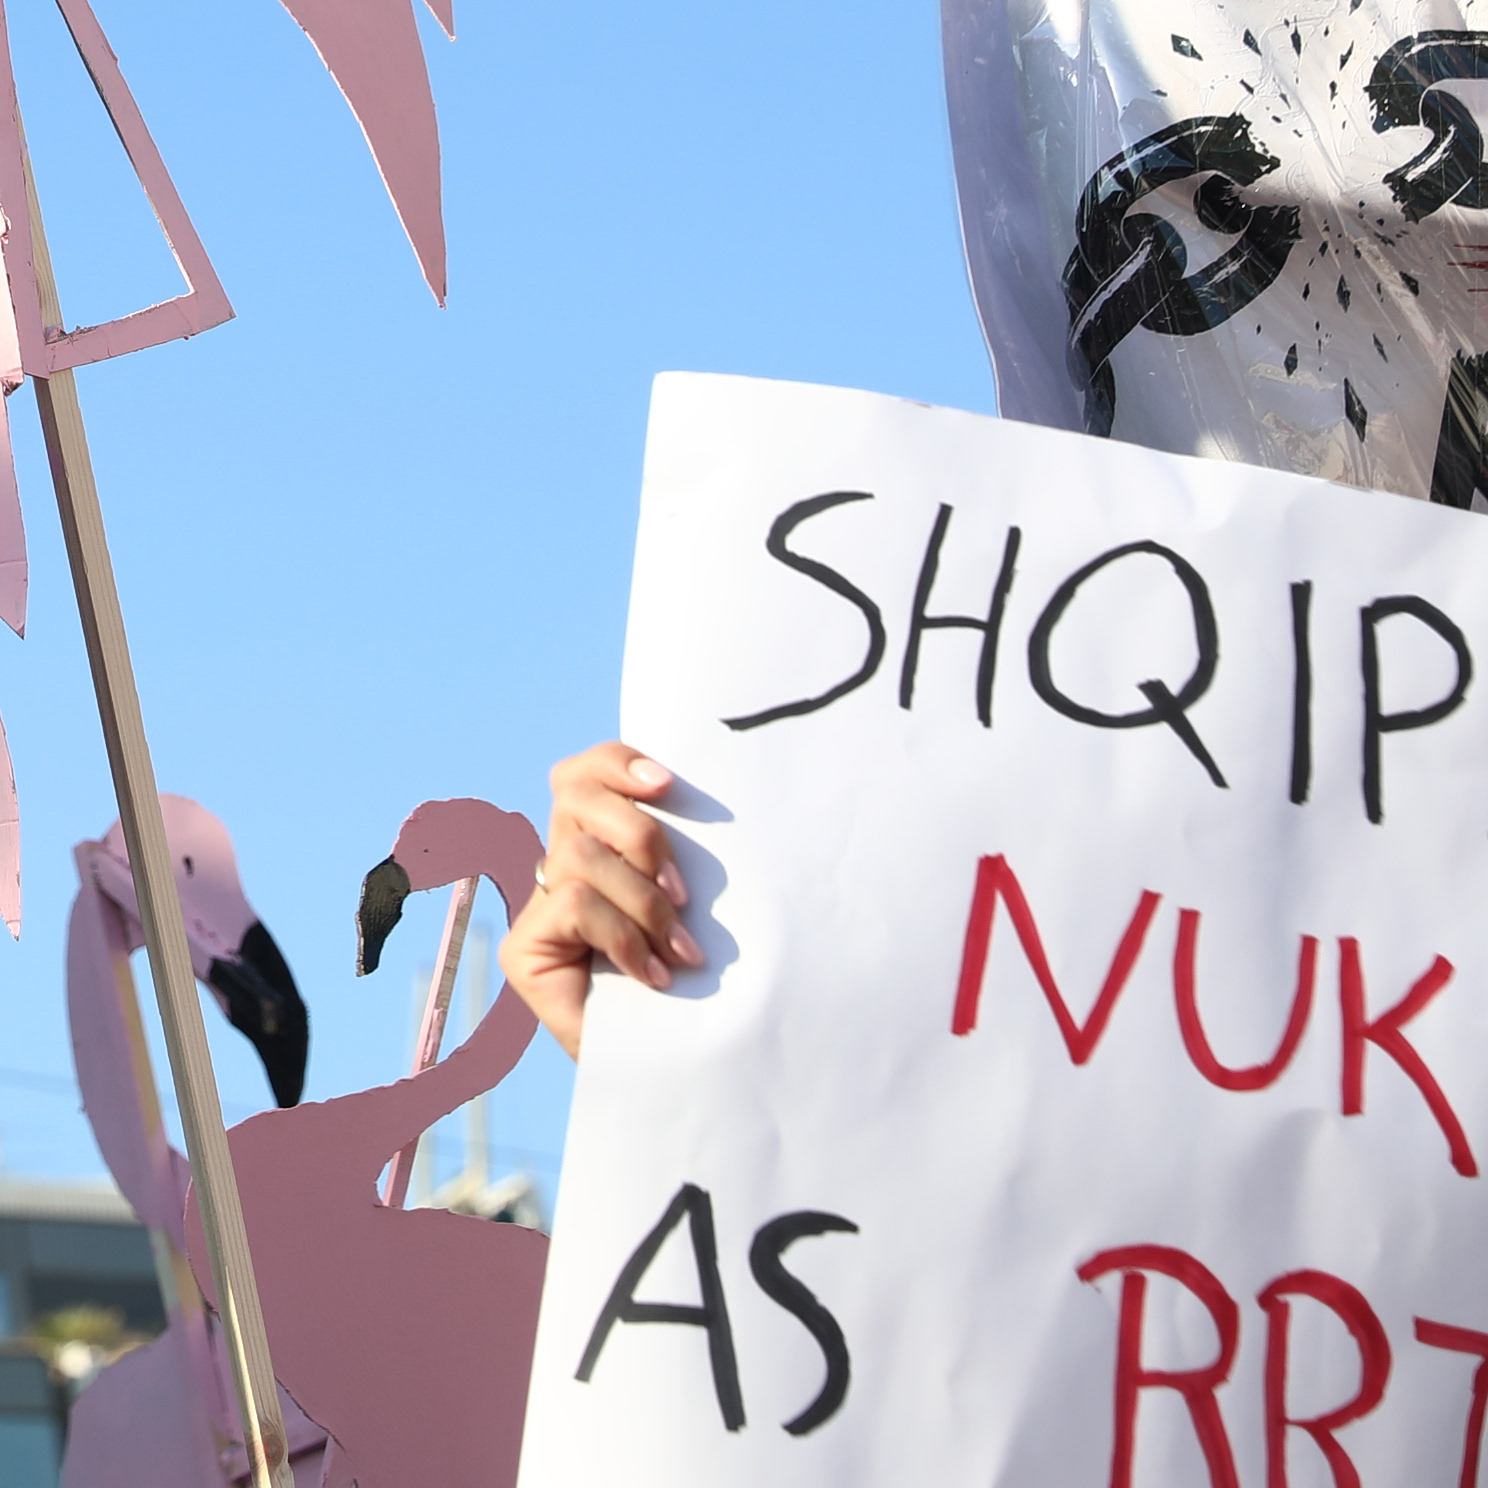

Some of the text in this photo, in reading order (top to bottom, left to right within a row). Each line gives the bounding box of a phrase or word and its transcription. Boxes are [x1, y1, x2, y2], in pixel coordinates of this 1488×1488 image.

[721, 491, 1474, 825] SHQIP
[951, 854, 1480, 1179] NUK
[575, 1183, 860, 1436] AS
